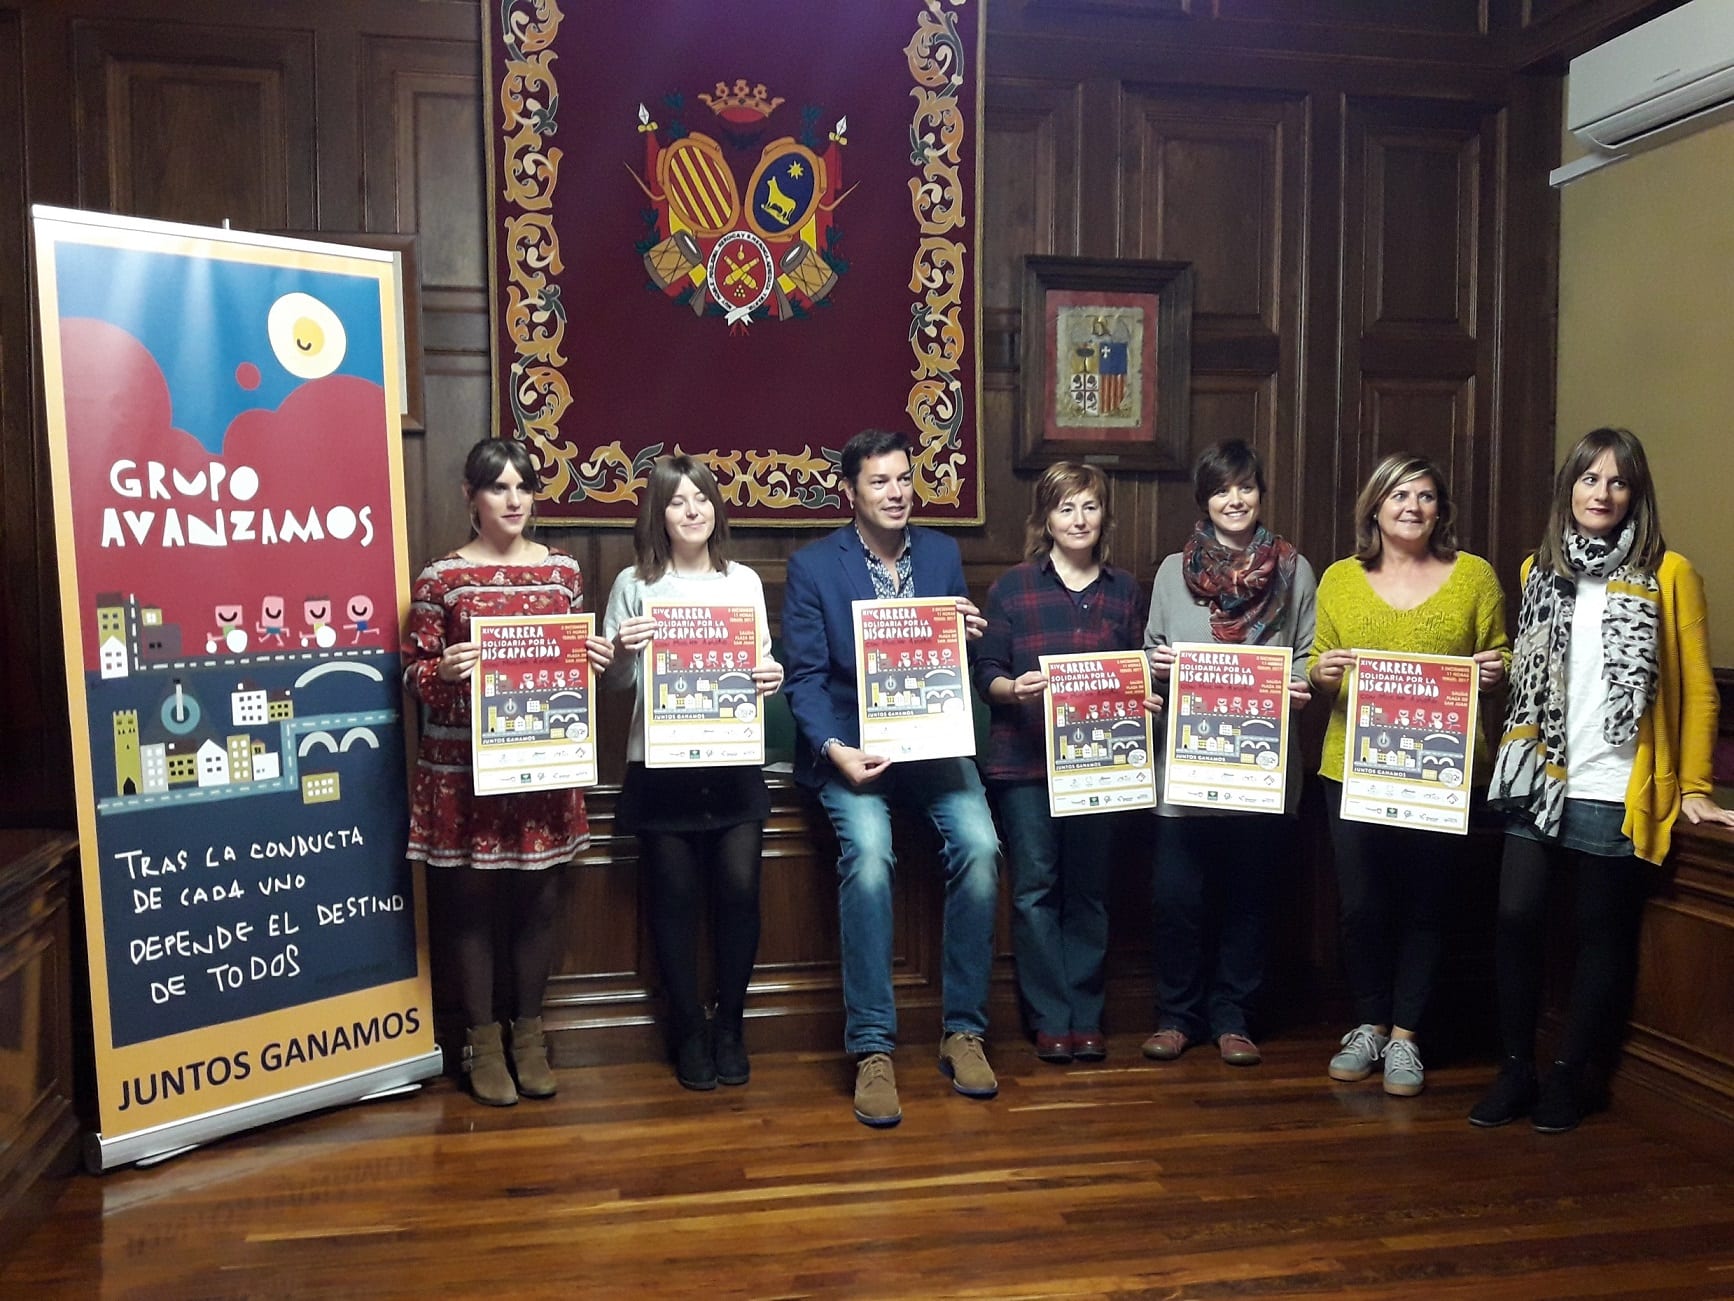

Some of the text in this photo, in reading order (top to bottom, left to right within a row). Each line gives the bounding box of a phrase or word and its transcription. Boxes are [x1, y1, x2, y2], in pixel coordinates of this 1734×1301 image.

[110, 459, 259, 501] GRUPO
[101, 505, 374, 548] AVANZAMOS
[663, 608, 711, 619] CARRERA
[872, 607, 916, 620] CARRERA
[863, 620, 901, 628] SOLIDARIA
[493, 625, 543, 639] CARRERA
[863, 625, 932, 640] DISCAPACIDAD
[482, 639, 526, 647] SOLIDARIA
[482, 644, 560, 660] DISCAPACIDAD
[1191, 652, 1238, 665] CARRERA
[1060, 660, 1103, 674] CARRERA
[1180, 663, 1221, 672] SOLIDARIA
[1371, 660, 1422, 675] CARRERA
[1051, 673, 1089, 682] SOLIDARIA
[1179, 670, 1254, 685] DISCAPACIDAD
[1359, 672, 1403, 681] SOLIDARIA
[1051, 677, 1119, 694] DISCAPACIDAD
[1358, 679, 1439, 697] DISCAPACIDAD
[115, 826, 364, 880] TRAS LA CONDUCTA
[133, 874, 305, 914] DE CADA UNO
[130, 895, 404, 965] DEPENDE EL DESTINO
[151, 975, 186, 1004] DE
[206, 944, 301, 992] TODOS
[118, 1007, 421, 1111] JUNTOS GANAMOS
